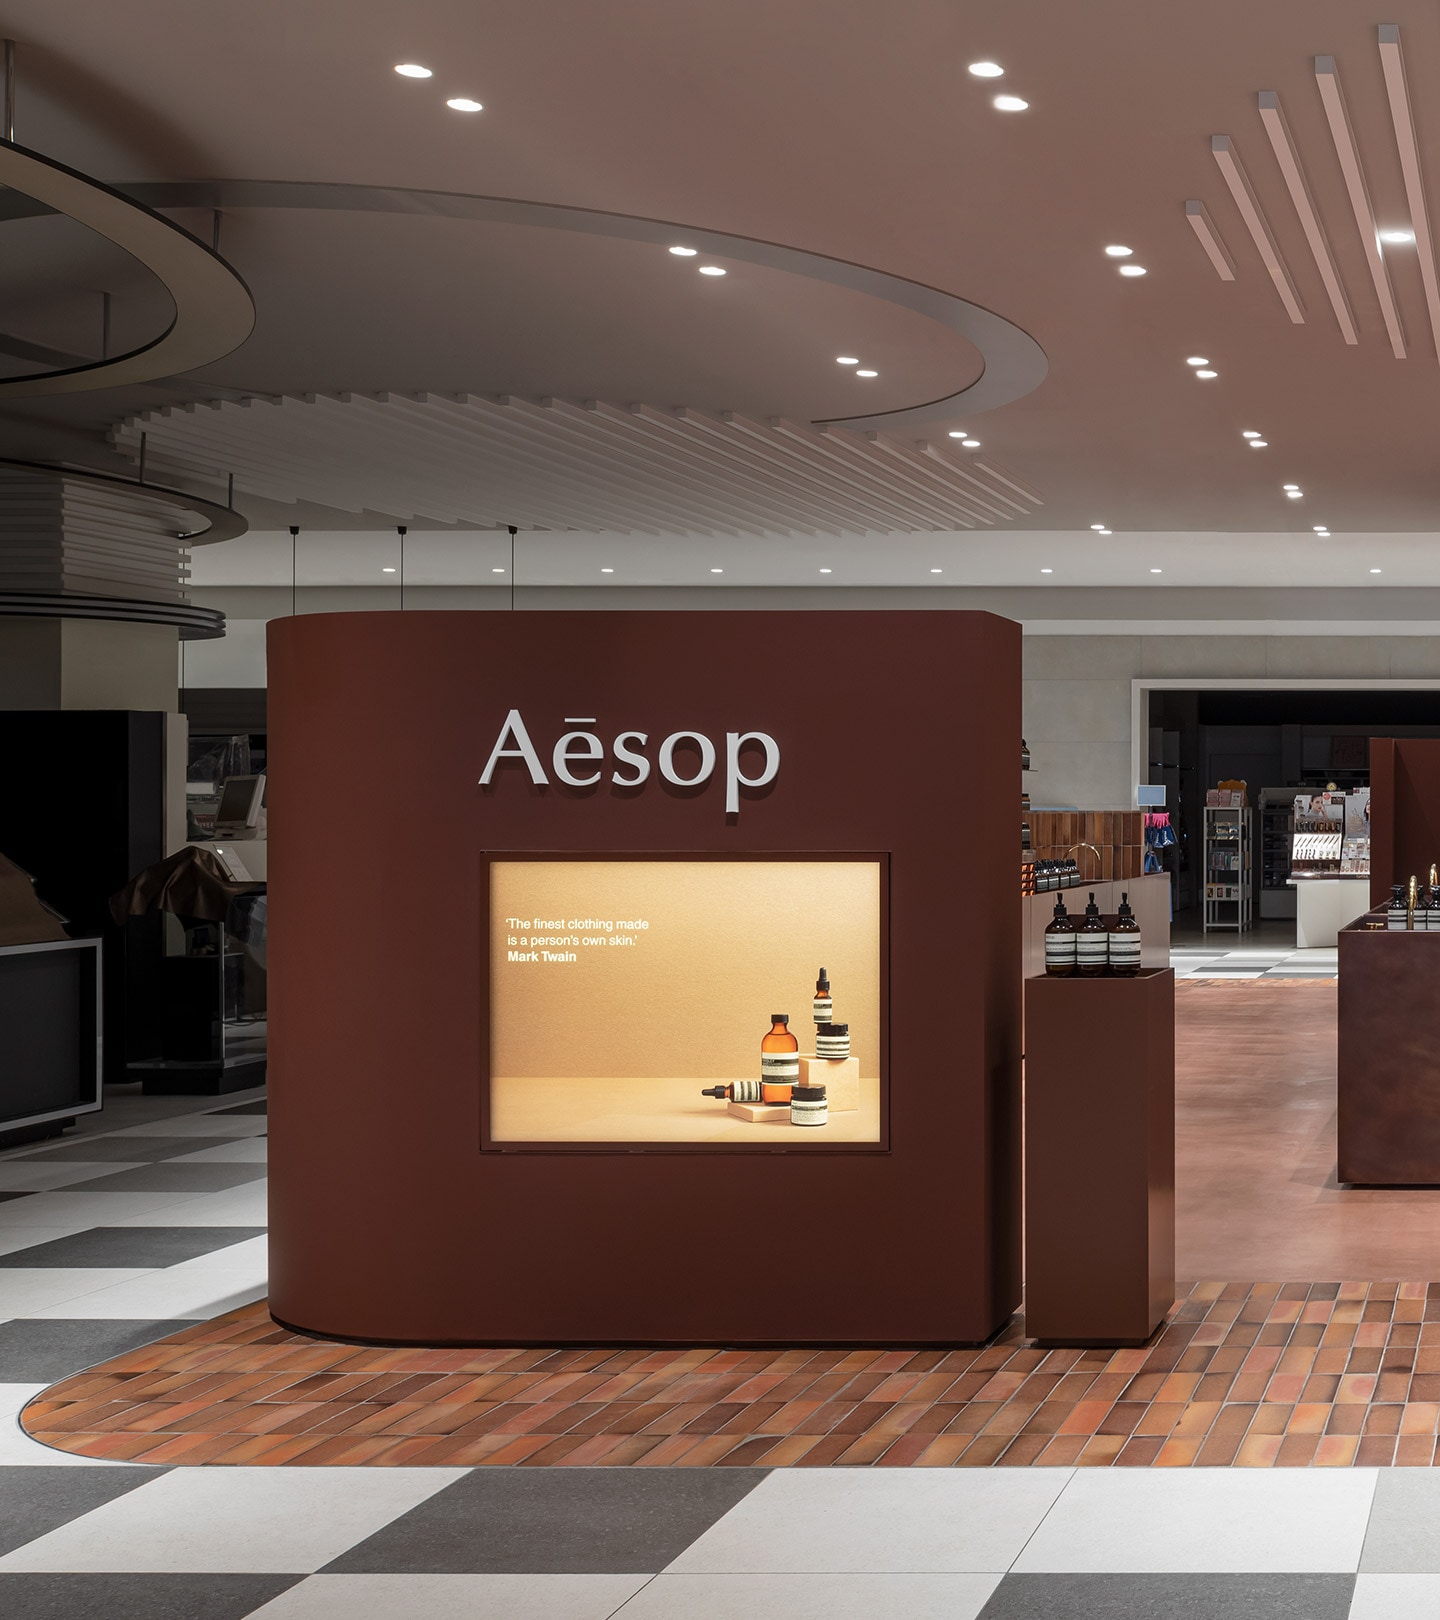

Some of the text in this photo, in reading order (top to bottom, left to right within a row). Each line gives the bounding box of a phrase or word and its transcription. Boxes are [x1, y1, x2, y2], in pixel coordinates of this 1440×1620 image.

[478, 709, 781, 813] Aēsop
[533, 917, 565, 930] finest
[568, 917, 613, 932] clothing
[616, 918, 649, 930] made
[507, 934, 517, 946] is
[520, 936, 528, 946] a
[582, 936, 607, 946] own
[507, 950, 577, 962] Mark Twain
